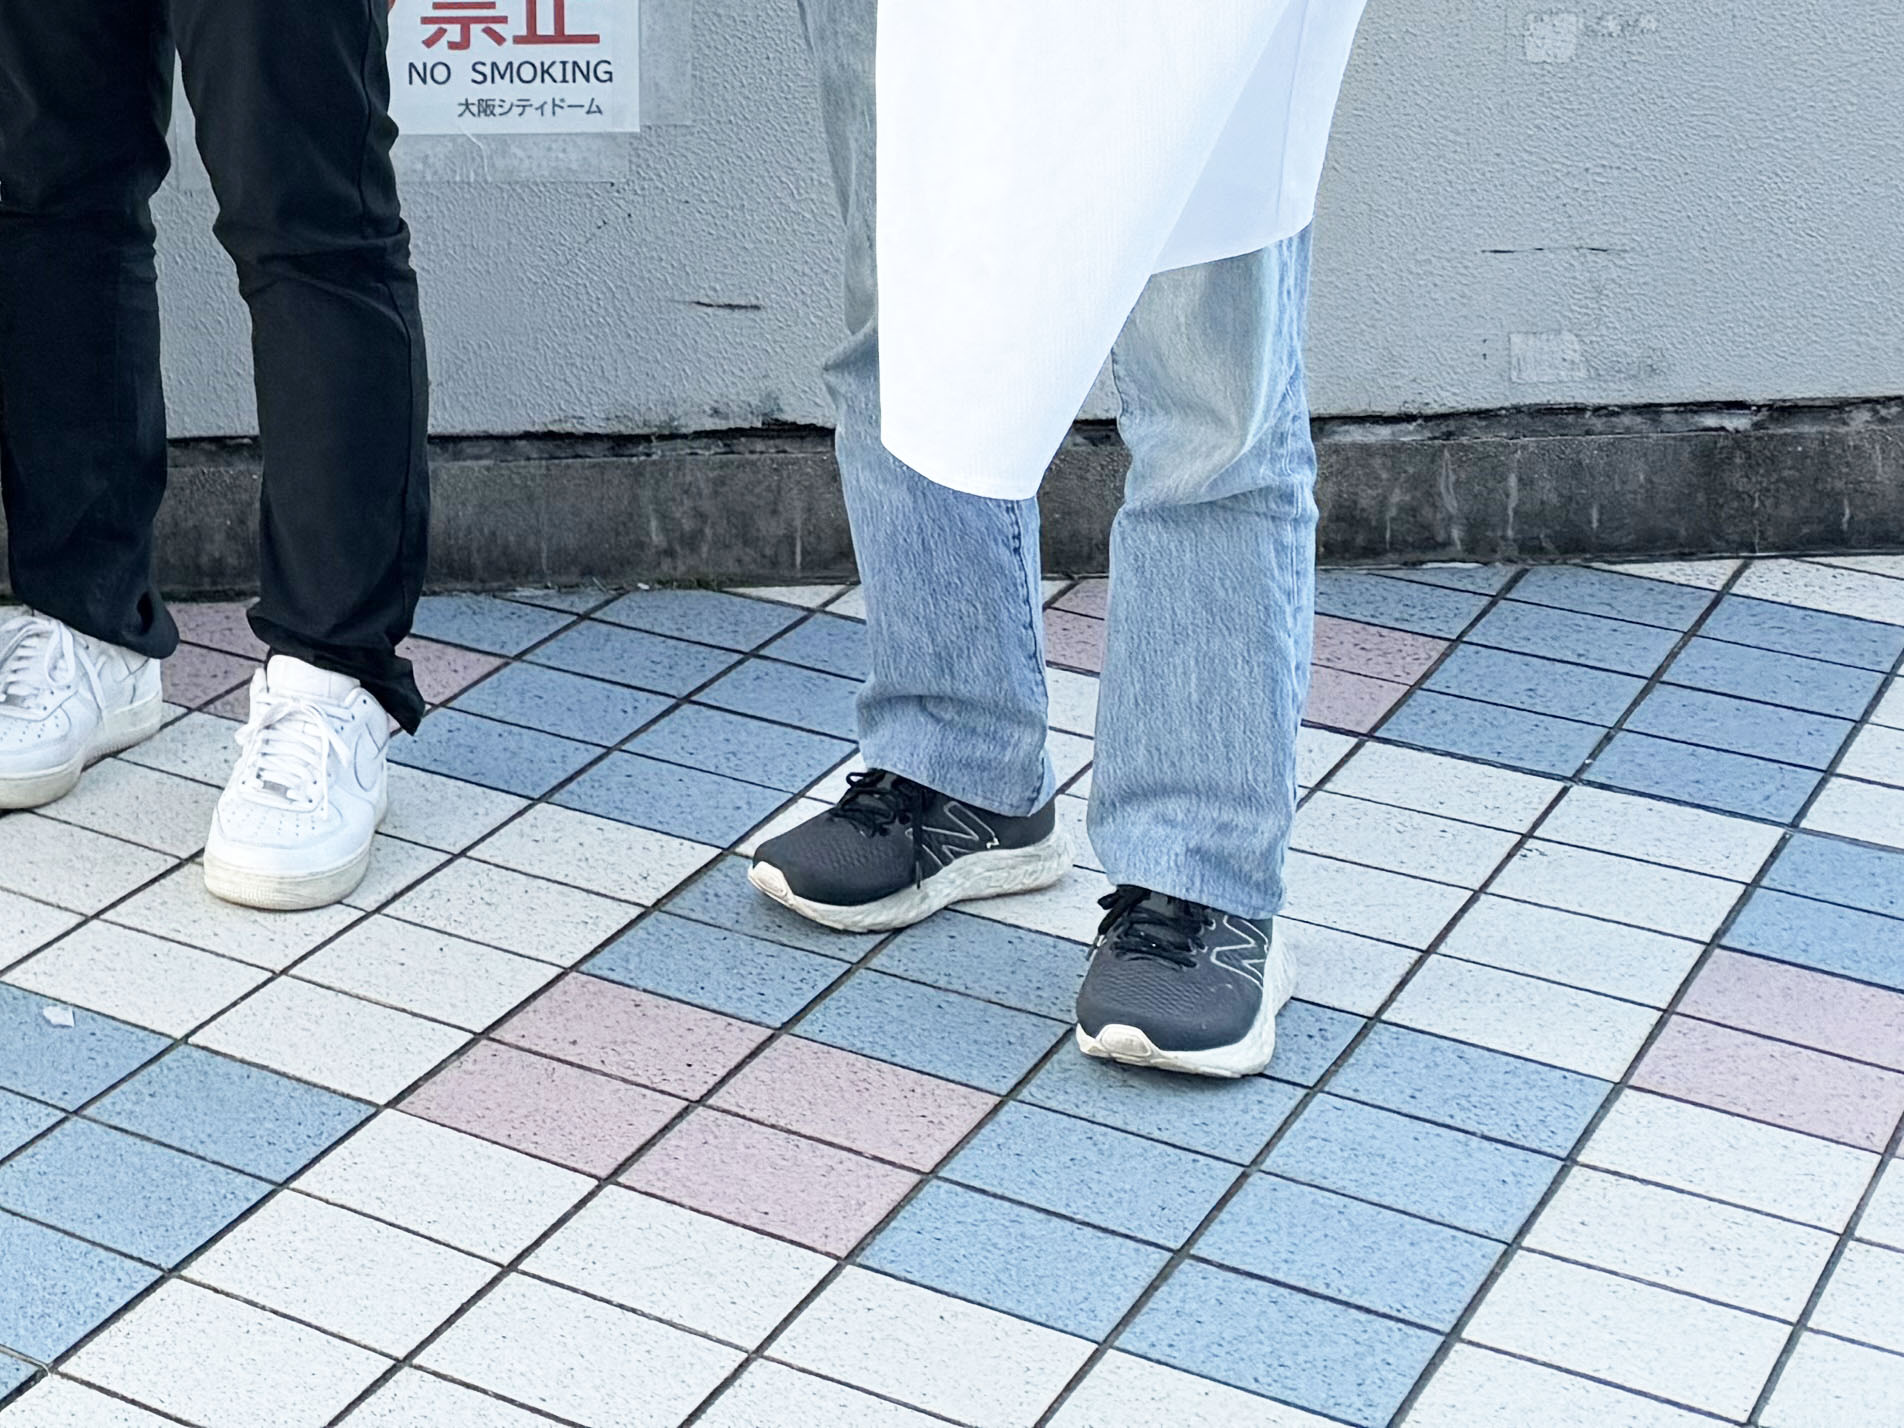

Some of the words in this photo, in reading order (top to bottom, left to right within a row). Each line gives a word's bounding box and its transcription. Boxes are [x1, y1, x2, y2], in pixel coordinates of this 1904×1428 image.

[408, 61, 451, 86] NO
[471, 59, 613, 85] SMOKING
[457, 97, 603, 118] 大阪シティドーム
